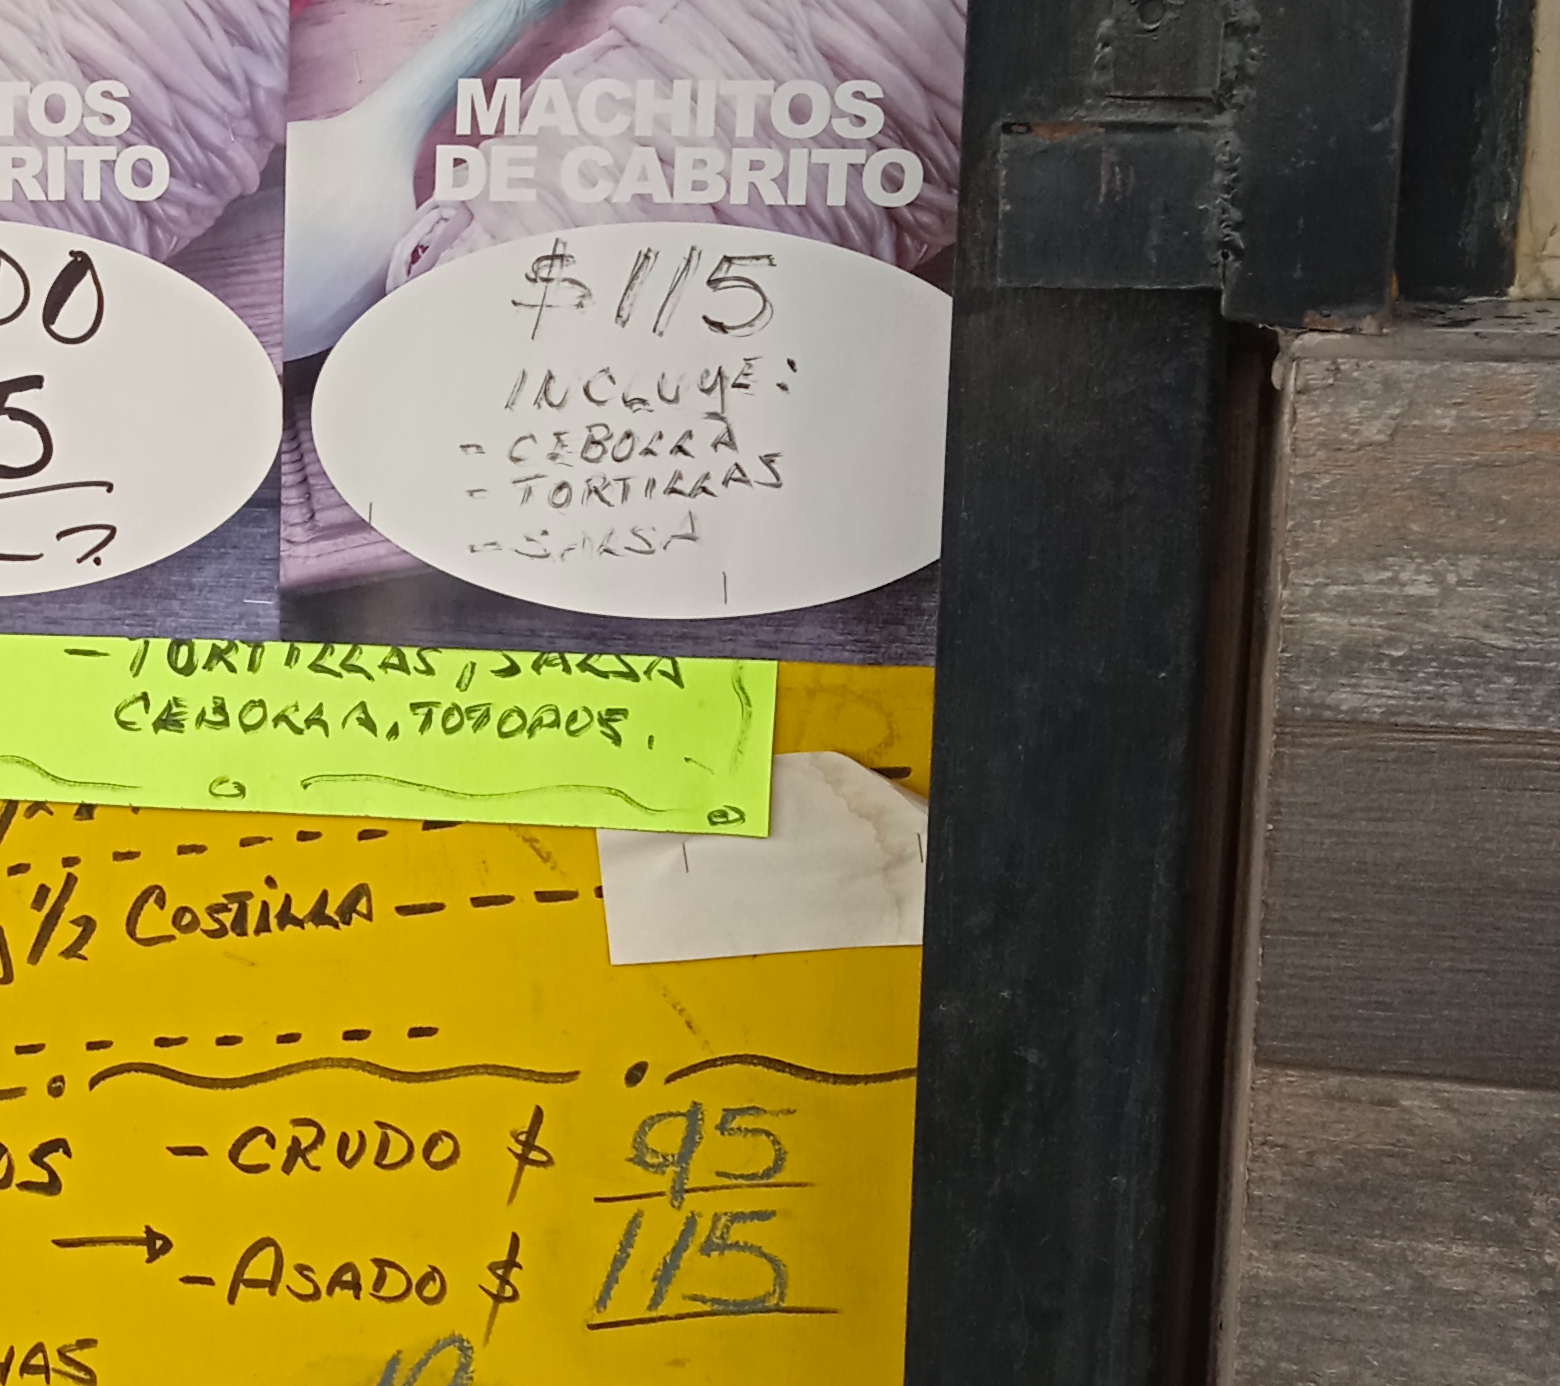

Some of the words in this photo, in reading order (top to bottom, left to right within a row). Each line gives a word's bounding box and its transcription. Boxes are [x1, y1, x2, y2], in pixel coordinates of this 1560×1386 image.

[454, 77, 886, 140] MACHITOS
[433, 144, 538, 203] DE
[559, 145, 924, 208] CABRITO
[26, 871, 98, 966] 1/2
[125, 875, 374, 947] COSTILLA
[227, 1116, 461, 1175] CRUDO
[627, 1100, 797, 1211] 95
[594, 1208, 789, 1314] 115
